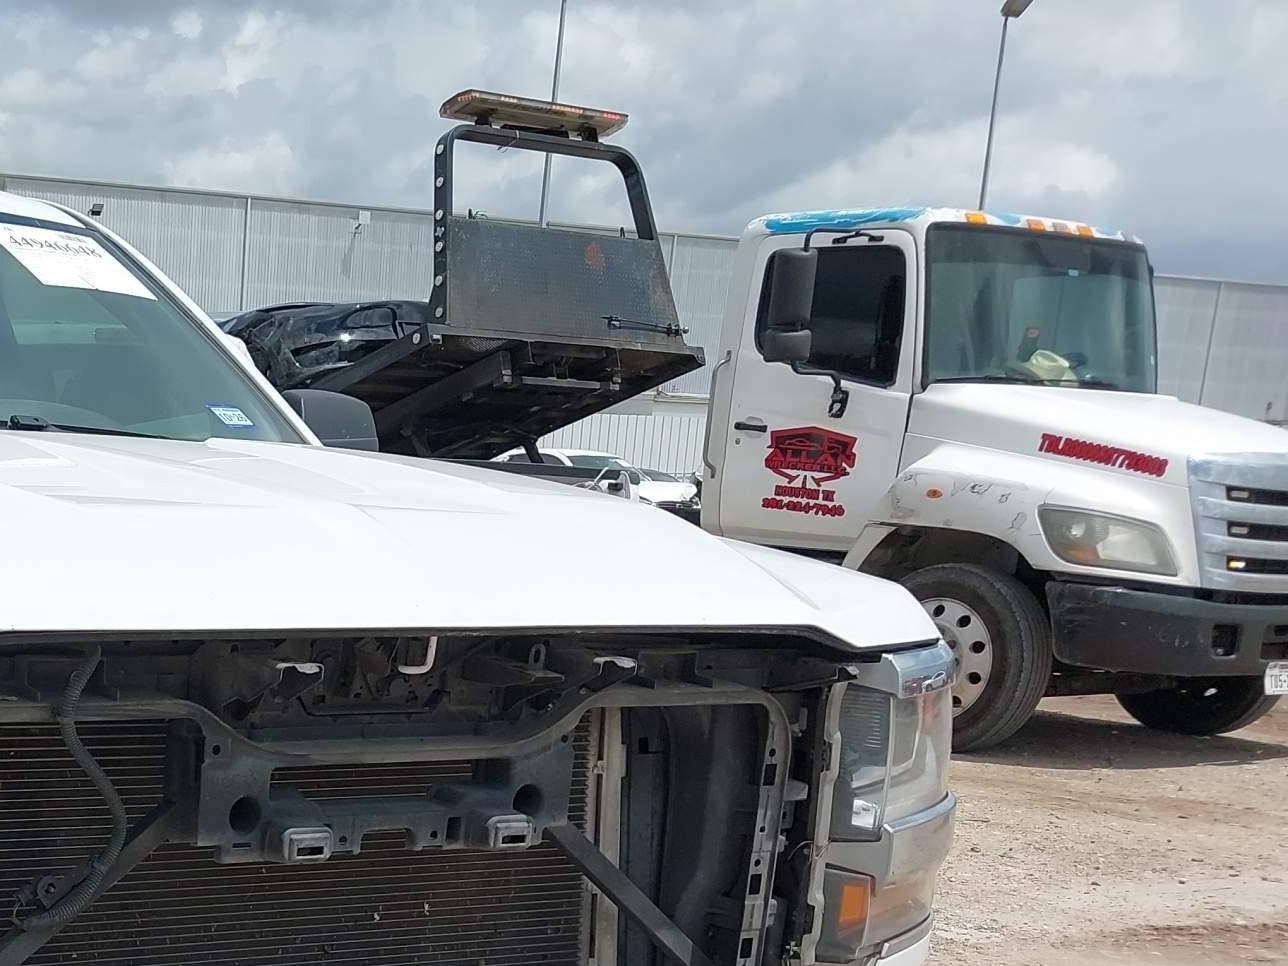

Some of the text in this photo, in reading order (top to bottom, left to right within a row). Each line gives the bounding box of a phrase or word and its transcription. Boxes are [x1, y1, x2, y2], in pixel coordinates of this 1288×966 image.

[765, 447, 856, 468] ALLAN
[774, 485, 836, 502] HOUSTON TX
